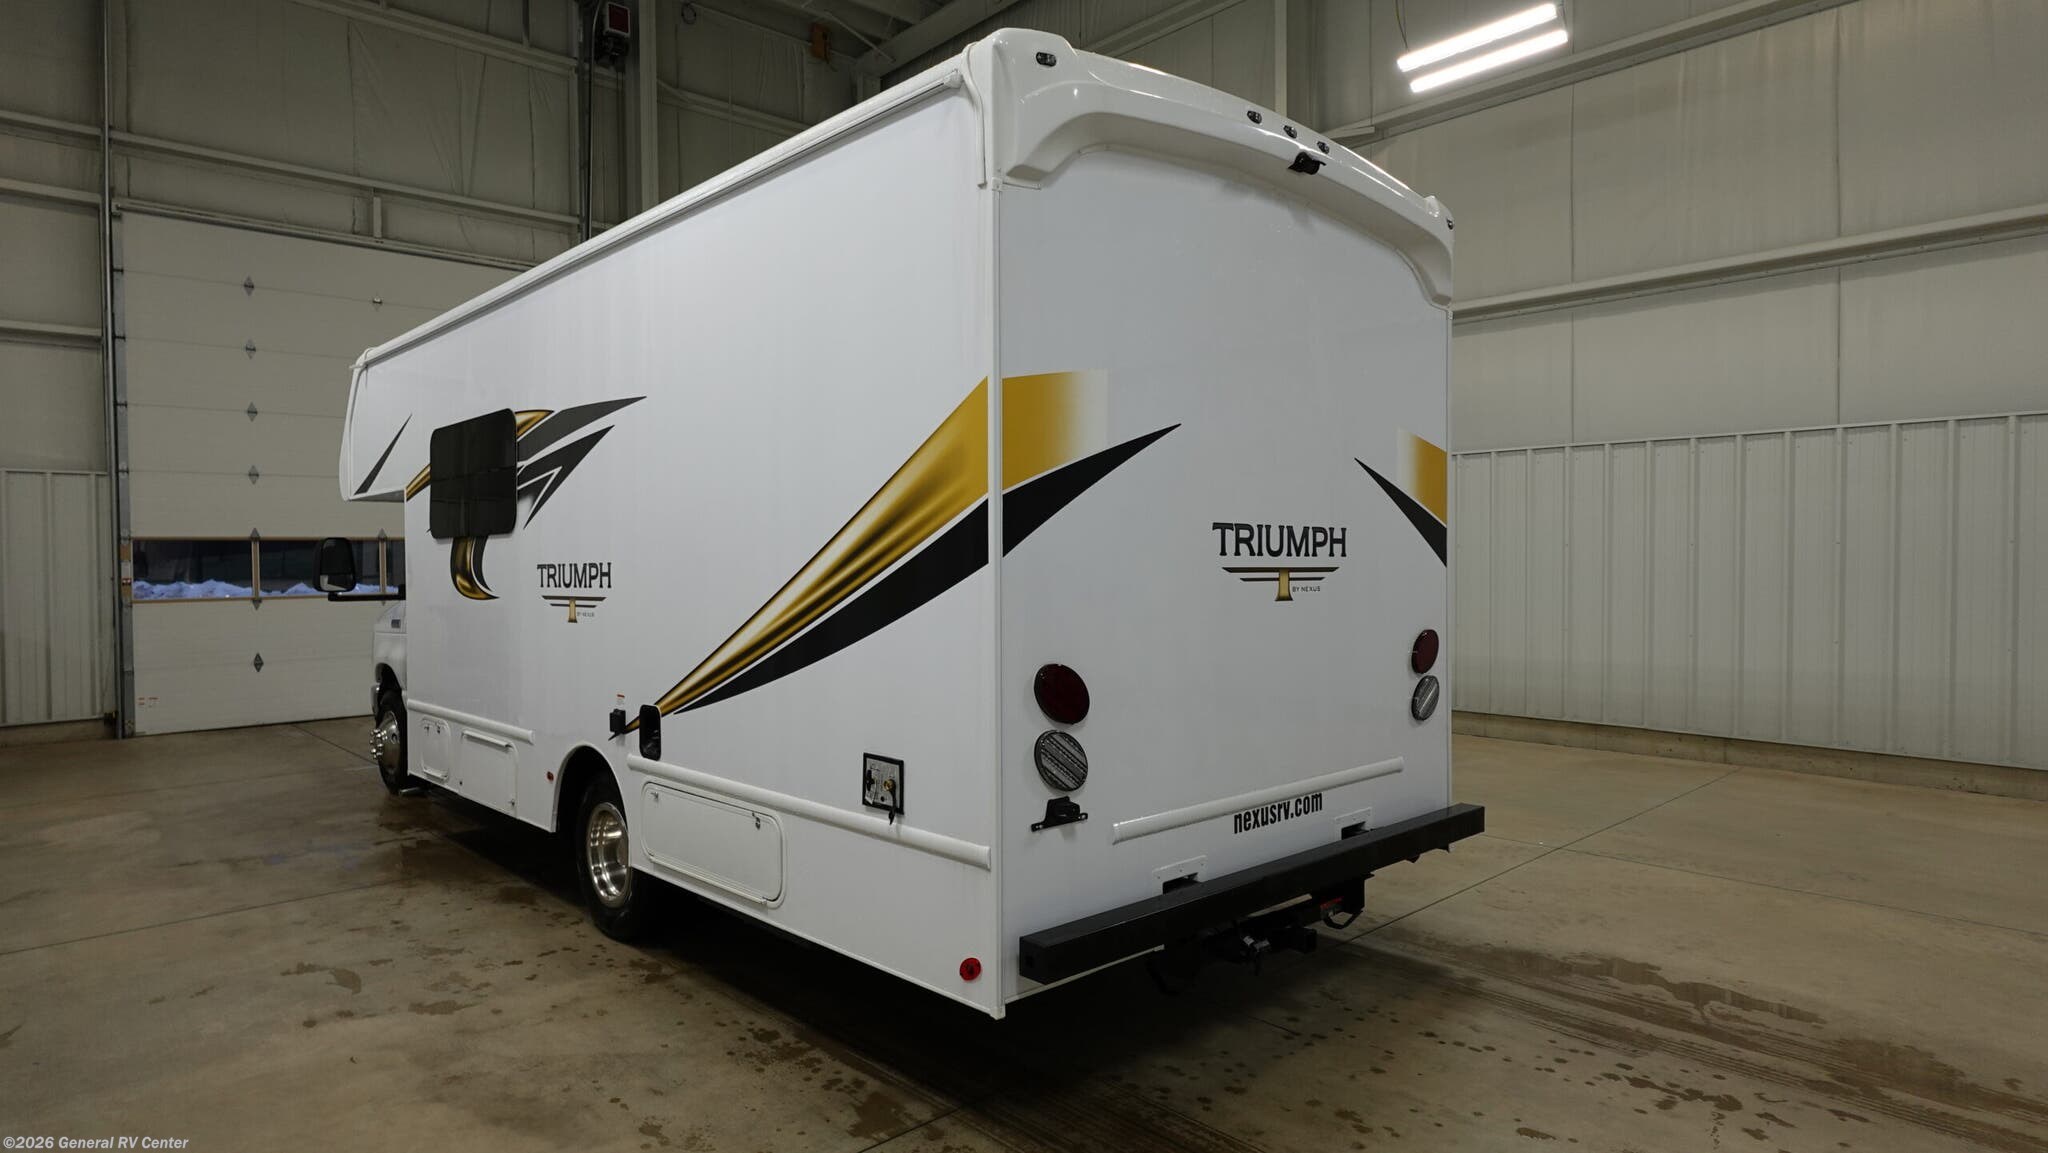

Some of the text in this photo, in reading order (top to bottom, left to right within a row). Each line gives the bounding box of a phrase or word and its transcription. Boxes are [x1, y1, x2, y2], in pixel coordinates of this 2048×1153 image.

[1212, 522, 1347, 557] TRIUMPH
[537, 562, 612, 589] TRIUMPH
[1234, 793, 1322, 834] nexusrv.com
